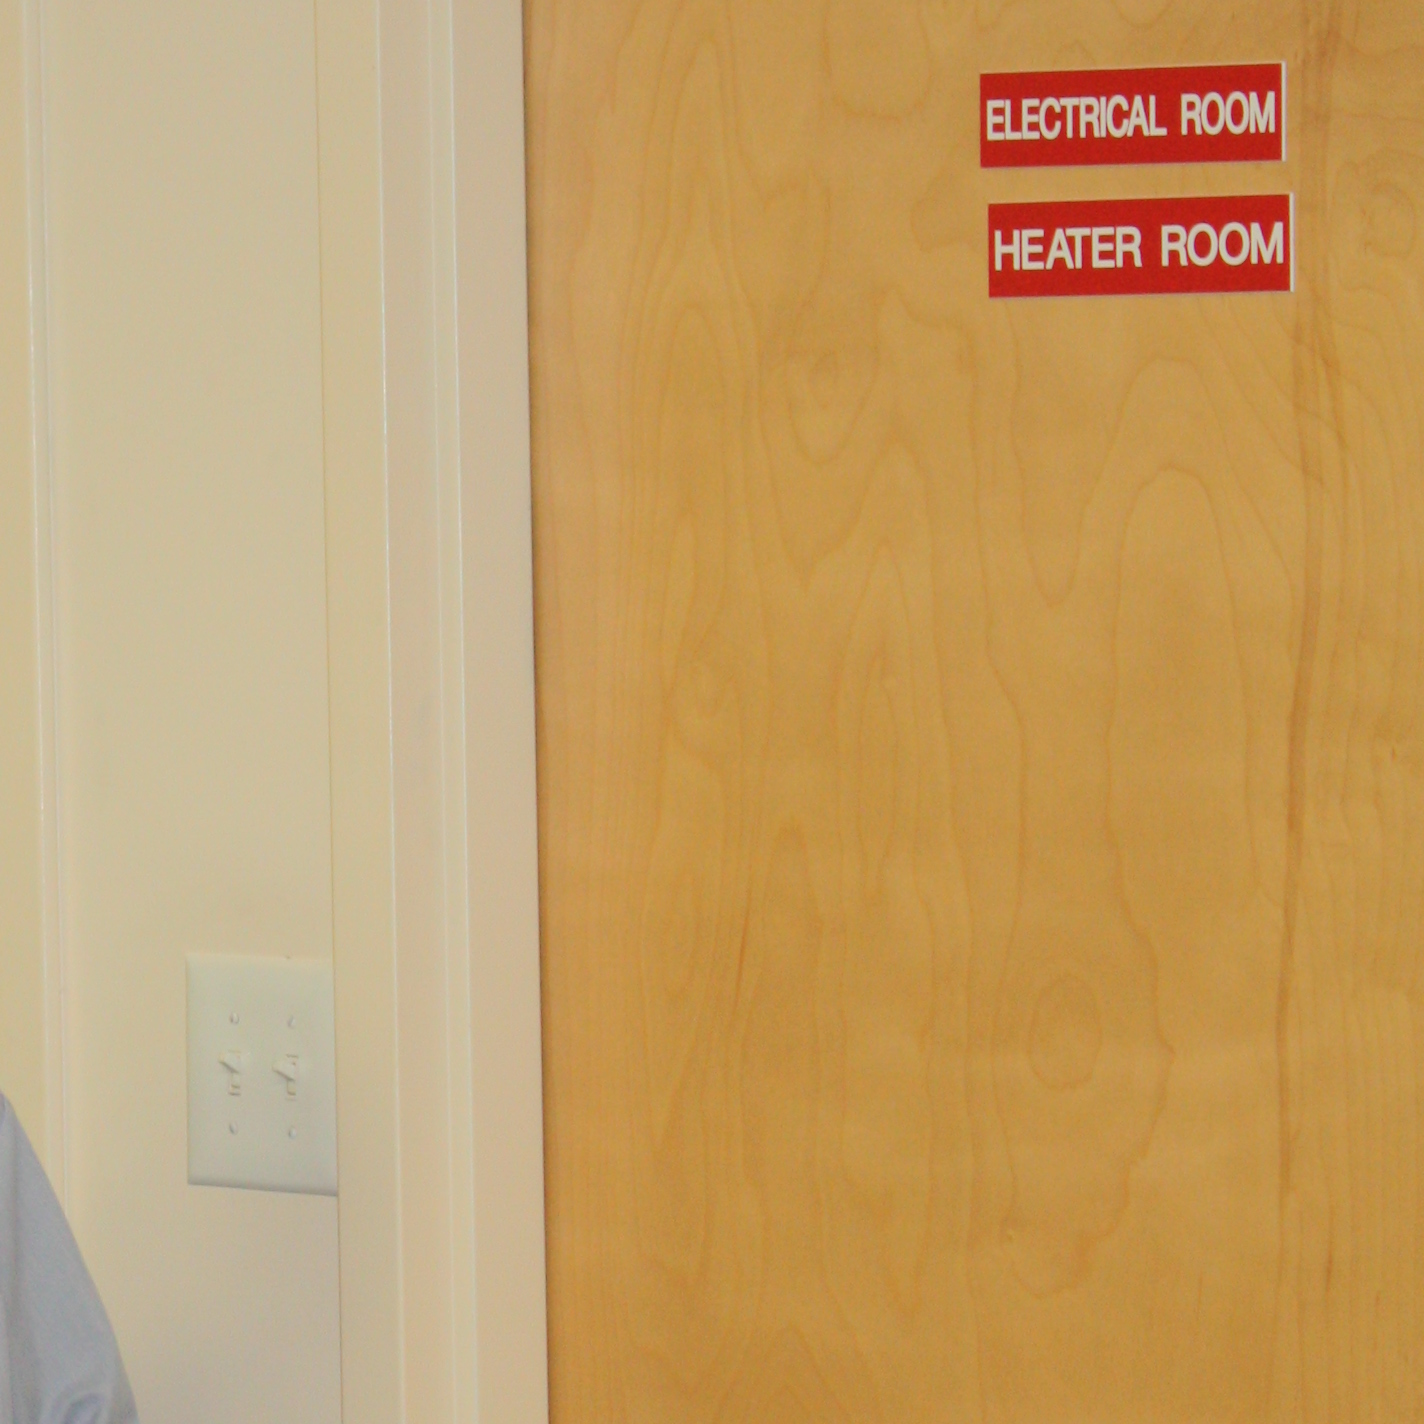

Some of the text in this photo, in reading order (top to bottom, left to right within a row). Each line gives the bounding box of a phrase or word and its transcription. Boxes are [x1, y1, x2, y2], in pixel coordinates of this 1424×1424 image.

[986, 90, 1276, 141] ELECTRICAL ROOM
[993, 221, 1284, 271] HEATER ROOM
